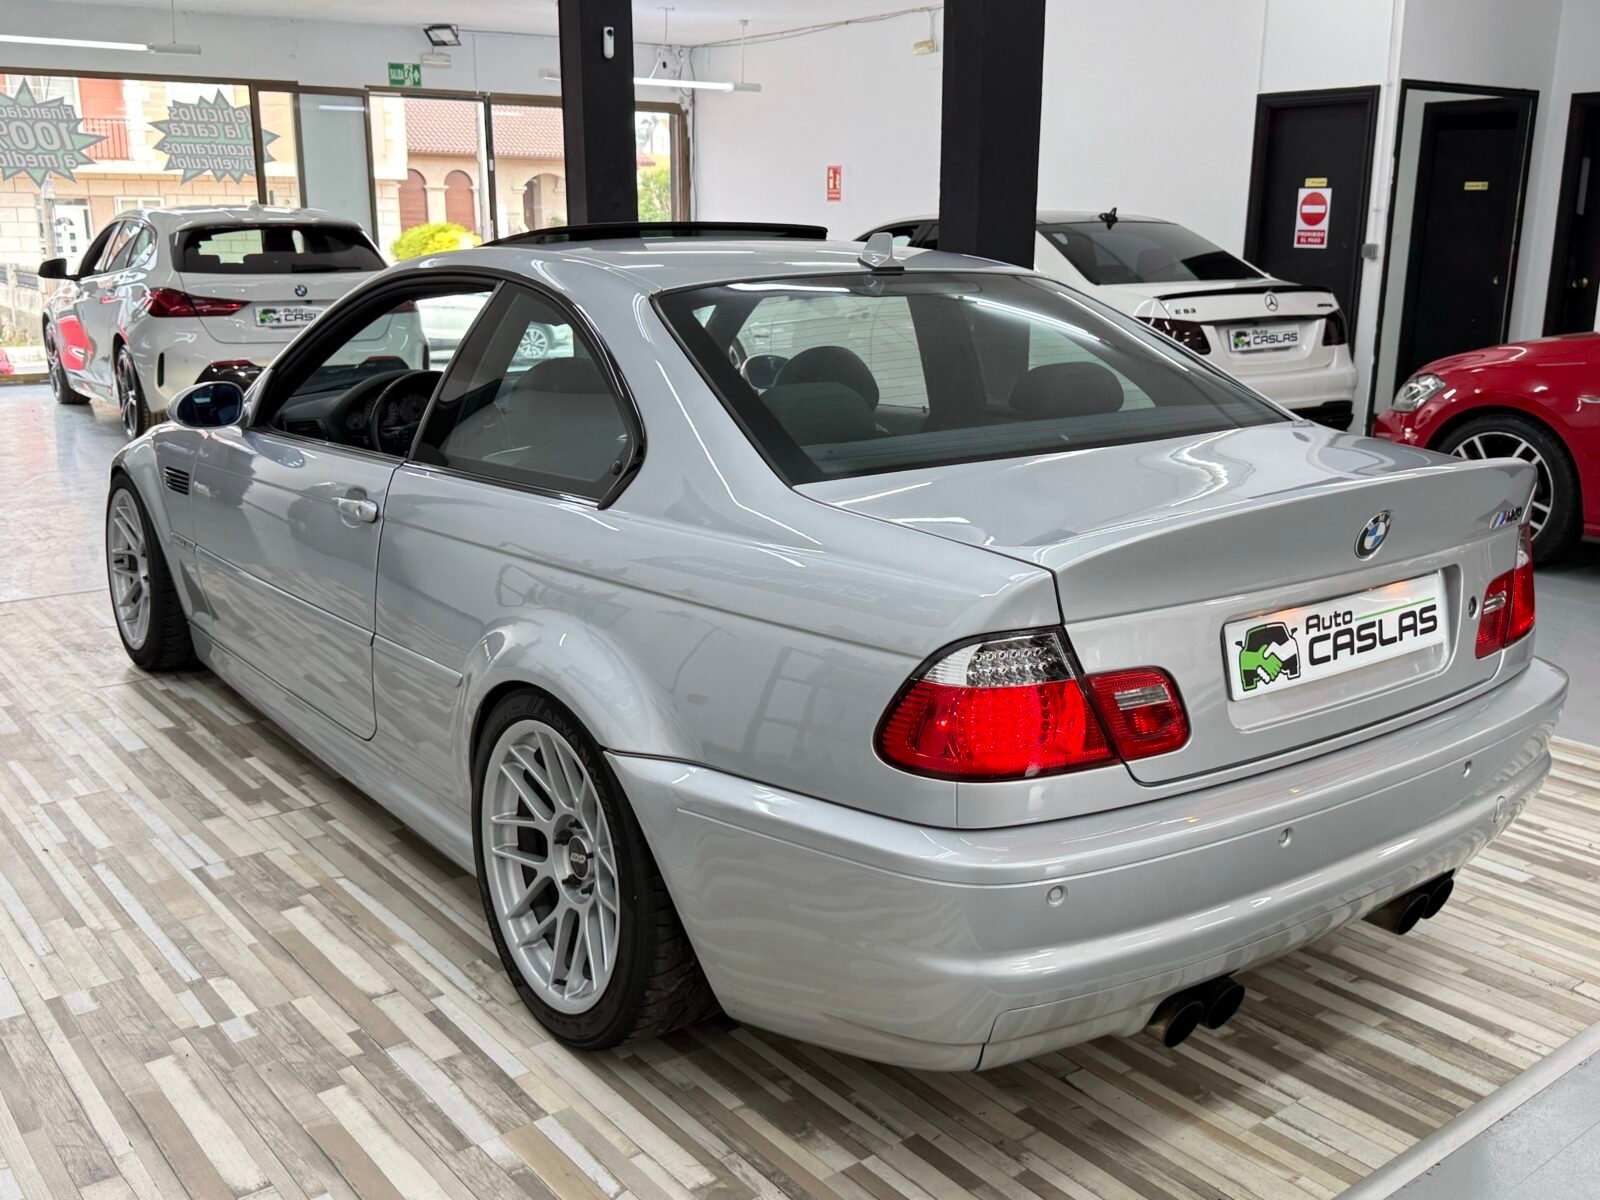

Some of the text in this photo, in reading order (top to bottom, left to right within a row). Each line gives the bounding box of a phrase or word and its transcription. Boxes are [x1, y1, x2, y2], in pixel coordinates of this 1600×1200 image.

[1253, 332, 1298, 345] CASLAS
[1305, 610, 1353, 634] Auto
[1308, 604, 1438, 666] CASLAS
